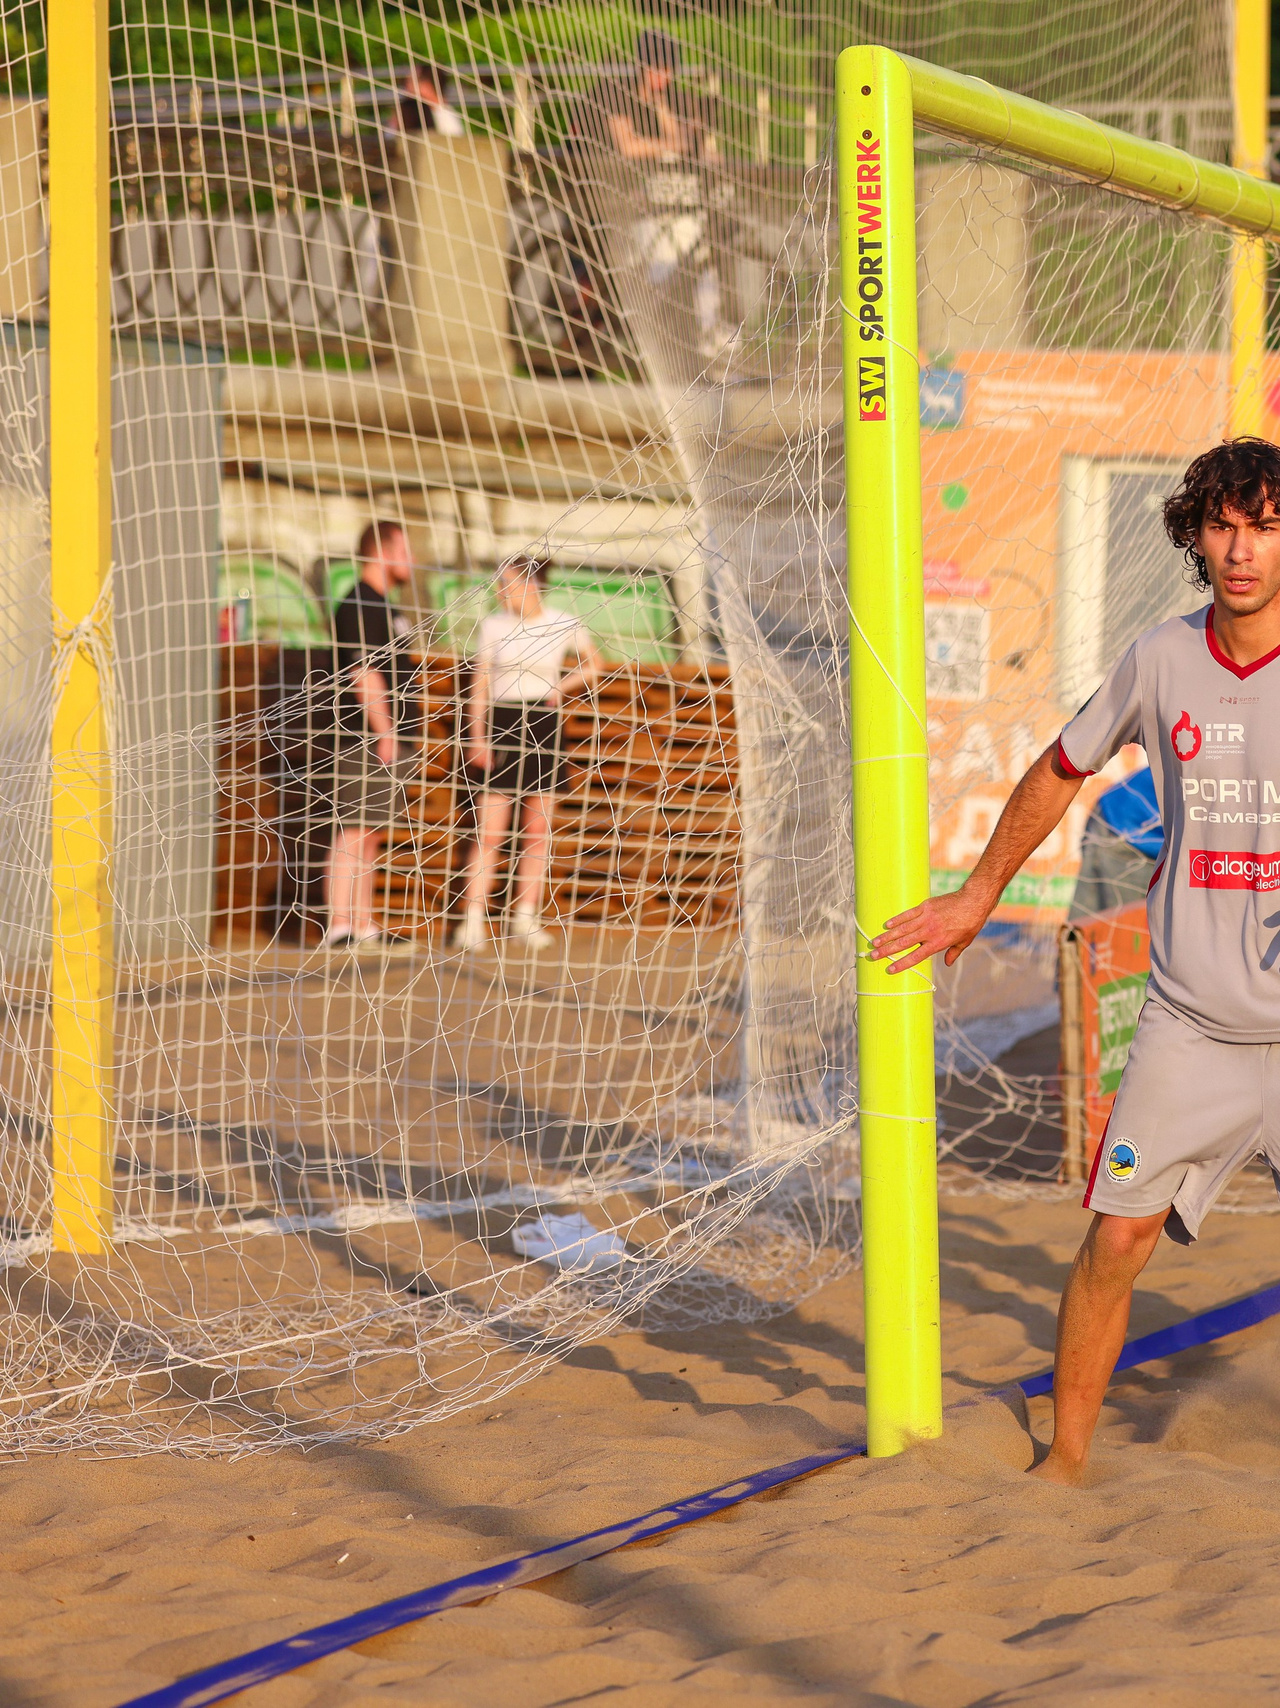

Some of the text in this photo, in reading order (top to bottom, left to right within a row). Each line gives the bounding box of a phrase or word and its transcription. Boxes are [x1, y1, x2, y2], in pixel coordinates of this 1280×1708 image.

[856, 138, 886, 414] SW SPORTWERK
[1180, 777, 1257, 803] PORT
